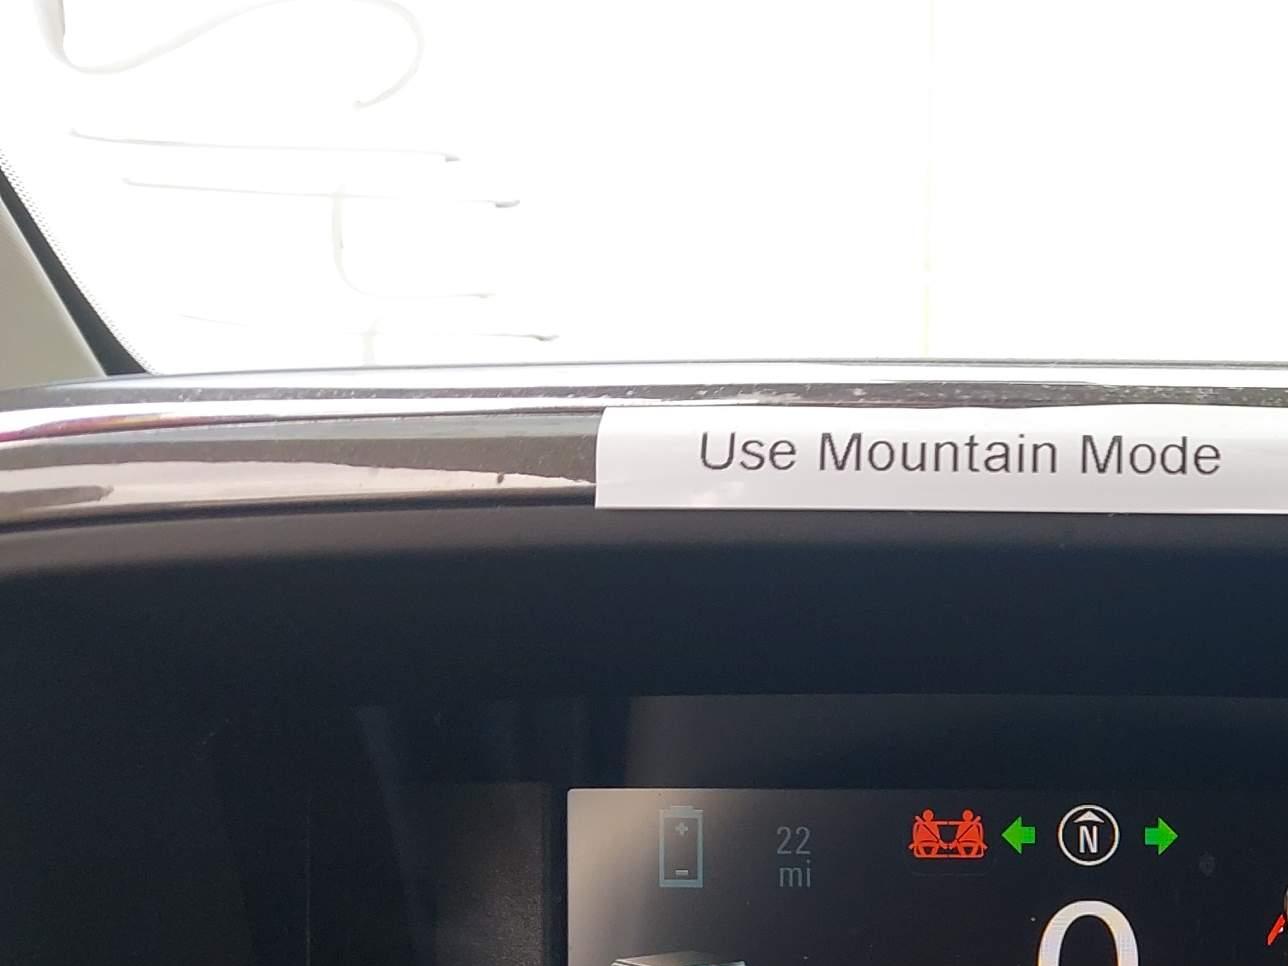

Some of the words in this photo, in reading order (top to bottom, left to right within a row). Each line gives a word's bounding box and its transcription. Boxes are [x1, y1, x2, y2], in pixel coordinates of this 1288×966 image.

[699, 431, 797, 472] Use
[818, 431, 1059, 475] Mountain
[1080, 434, 1222, 477] Mode
[775, 826, 812, 856] 22
[1078, 825, 1099, 854] N
[778, 860, 812, 888] mi
